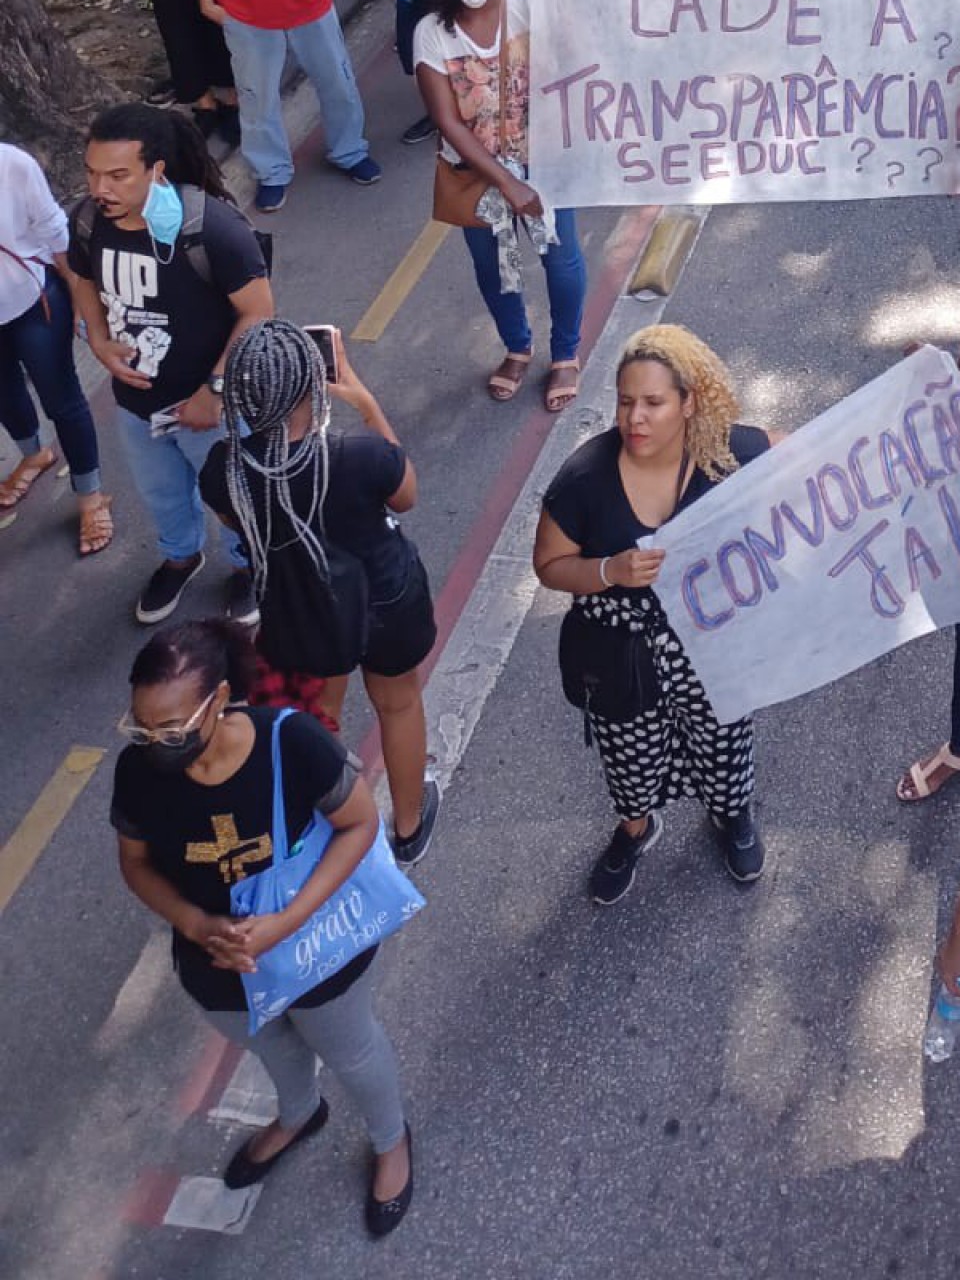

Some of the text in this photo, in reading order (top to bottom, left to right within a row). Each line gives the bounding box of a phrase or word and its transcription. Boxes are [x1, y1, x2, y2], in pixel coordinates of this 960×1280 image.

[618, 139, 826, 185] SEEDUC
[102, 247, 159, 308] UP
[295, 886, 363, 981] grato
